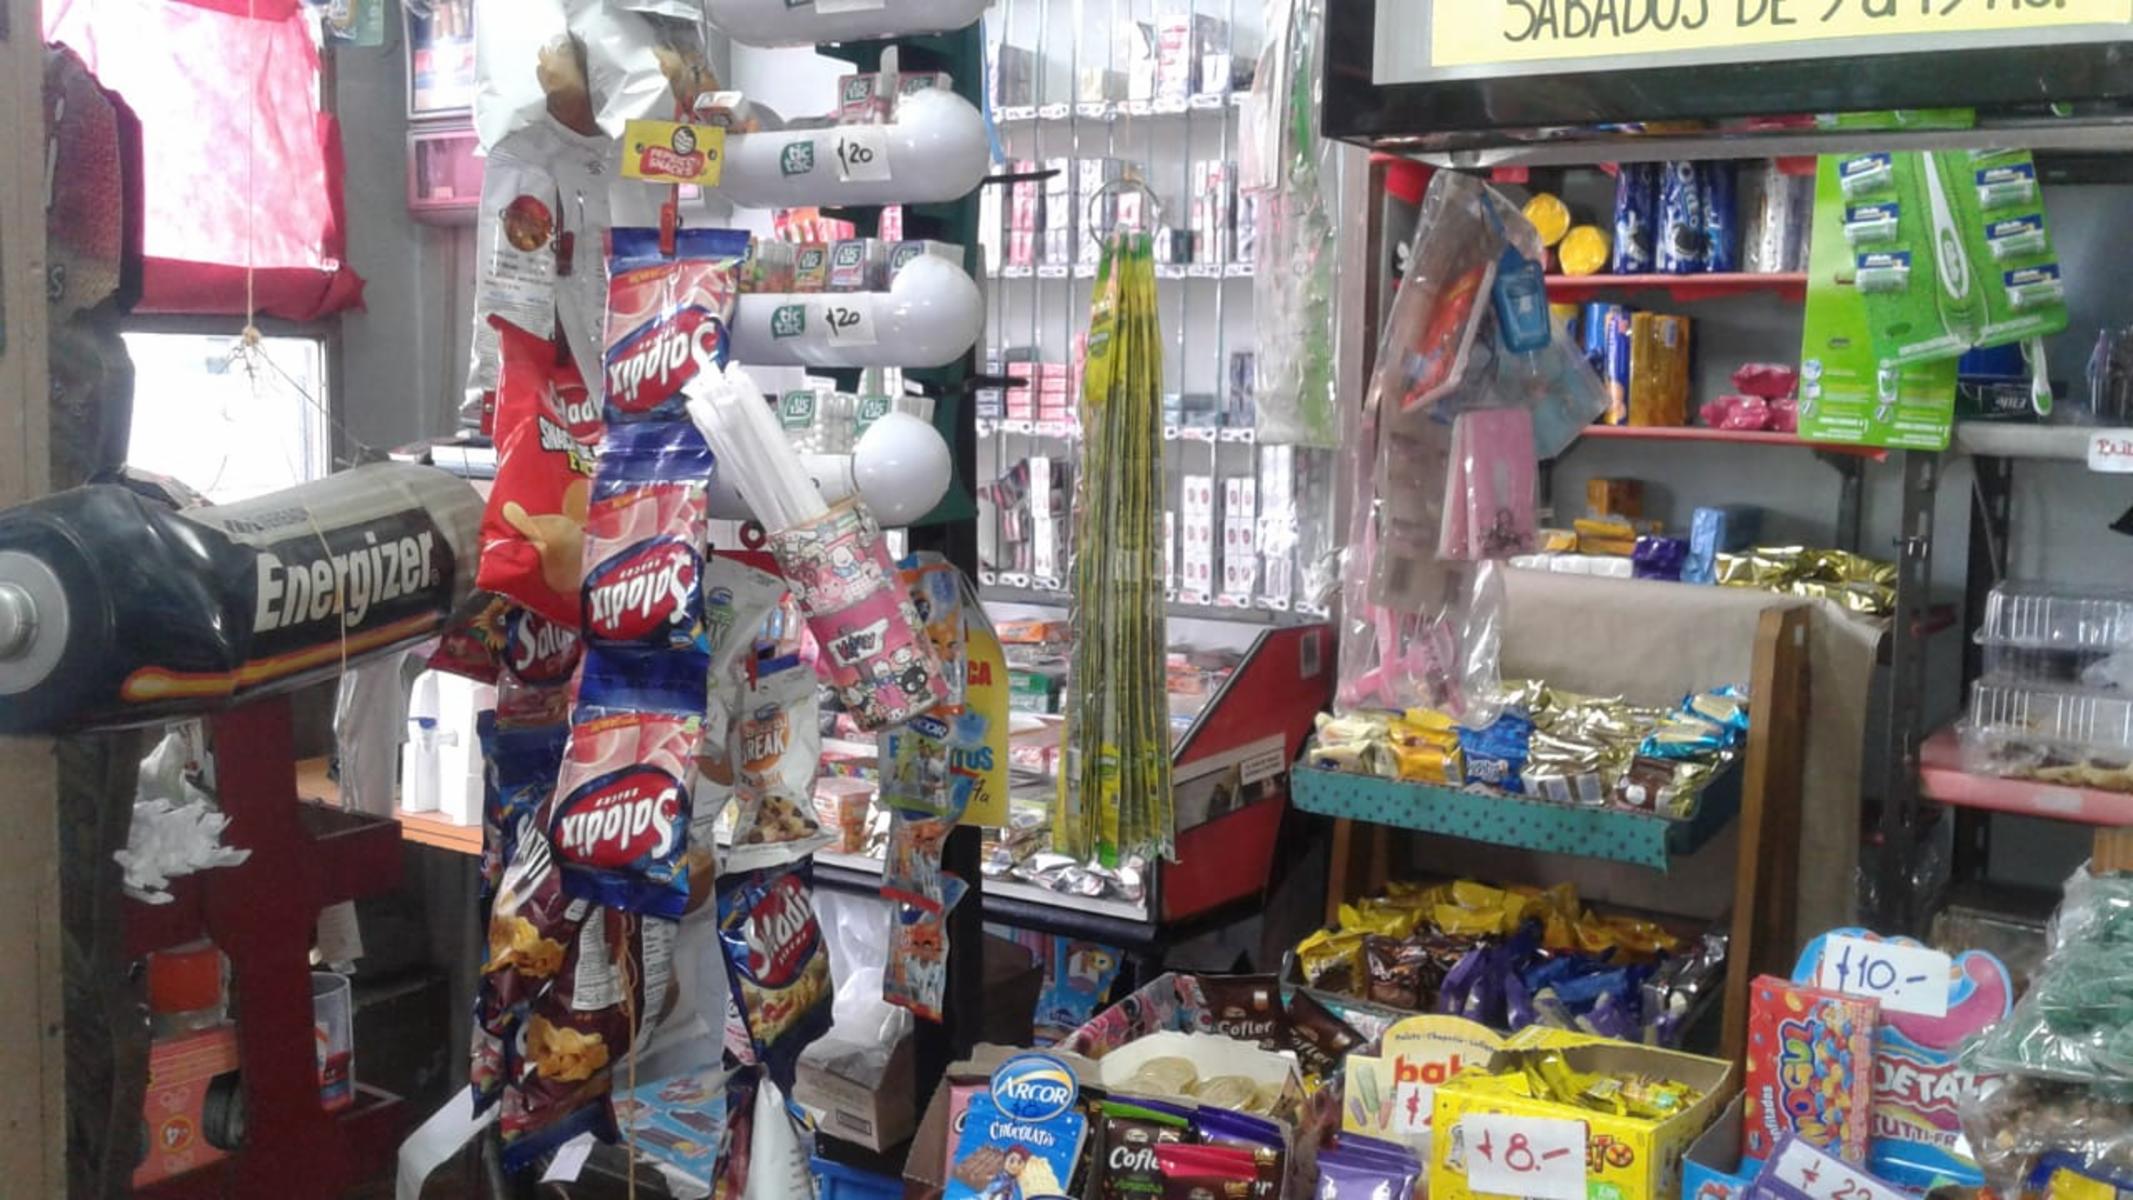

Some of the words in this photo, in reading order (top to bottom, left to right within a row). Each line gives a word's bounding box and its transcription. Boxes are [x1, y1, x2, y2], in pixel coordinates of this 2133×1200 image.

[252, 530, 434, 633] Energizer
[589, 553, 693, 630] Saladix
[561, 787, 679, 860] Saladix
[994, 1076, 1070, 1104] ARCOR
